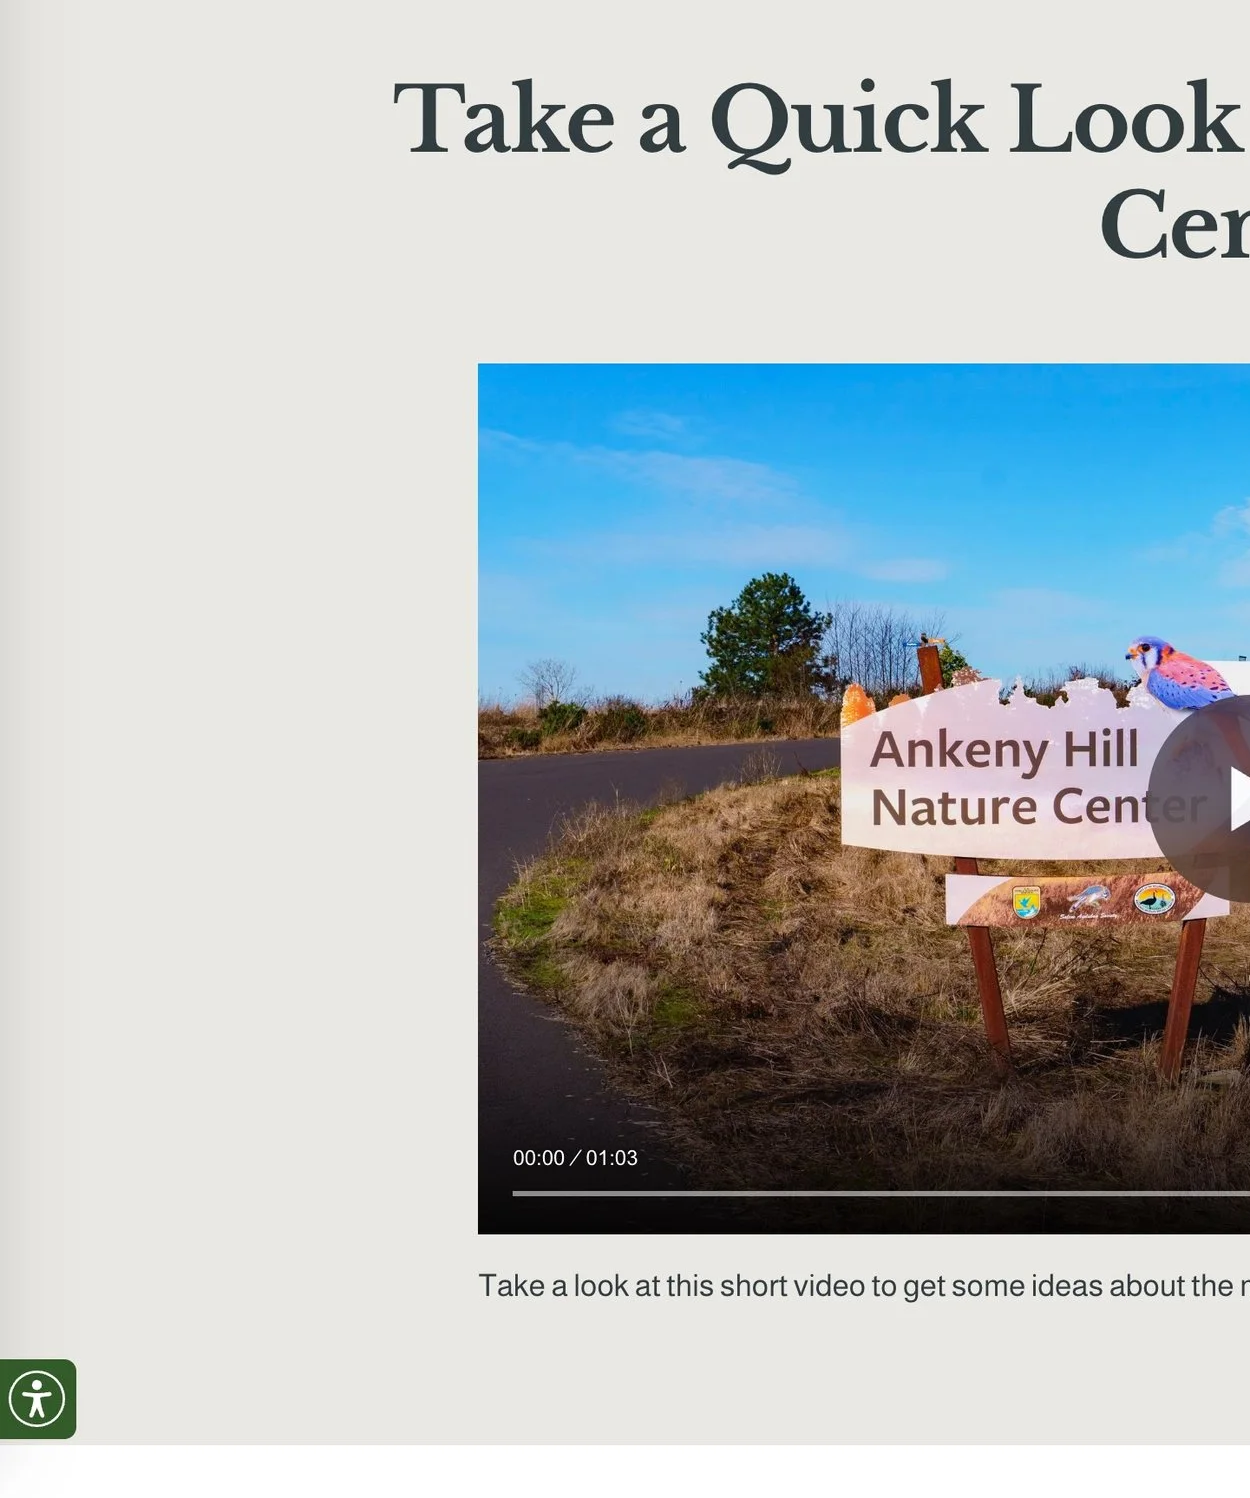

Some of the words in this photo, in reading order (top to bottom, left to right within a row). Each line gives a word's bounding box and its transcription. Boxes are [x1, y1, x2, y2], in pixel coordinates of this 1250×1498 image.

[393, 78, 615, 154] Take
[639, 103, 687, 154] a
[711, 77, 990, 176] Quick
[1009, 78, 1246, 154] Look
[869, 727, 1050, 780] Ankeny
[1065, 727, 1138, 767] Hill
[873, 788, 1037, 826] Nature
[1053, 787, 1208, 825] Center
[513, 1149, 565, 1166] 00:00
[586, 1149, 638, 1166] 01:03
[478, 1273, 545, 1297] Take
[552, 1279, 568, 1297] a
[575, 1273, 630, 1297] look
[635, 1275, 661, 1297] at
[666, 1273, 714, 1297] this
[720, 1273, 788, 1297] short
[793, 1273, 865, 1297] video
[871, 1275, 897, 1297] to
[903, 1275, 946, 1303] get
[952, 1279, 1025, 1297] some
[1032, 1273, 1103, 1297] ideas
[1109, 1273, 1186, 1297] about
[1191, 1273, 1234, 1297] the
